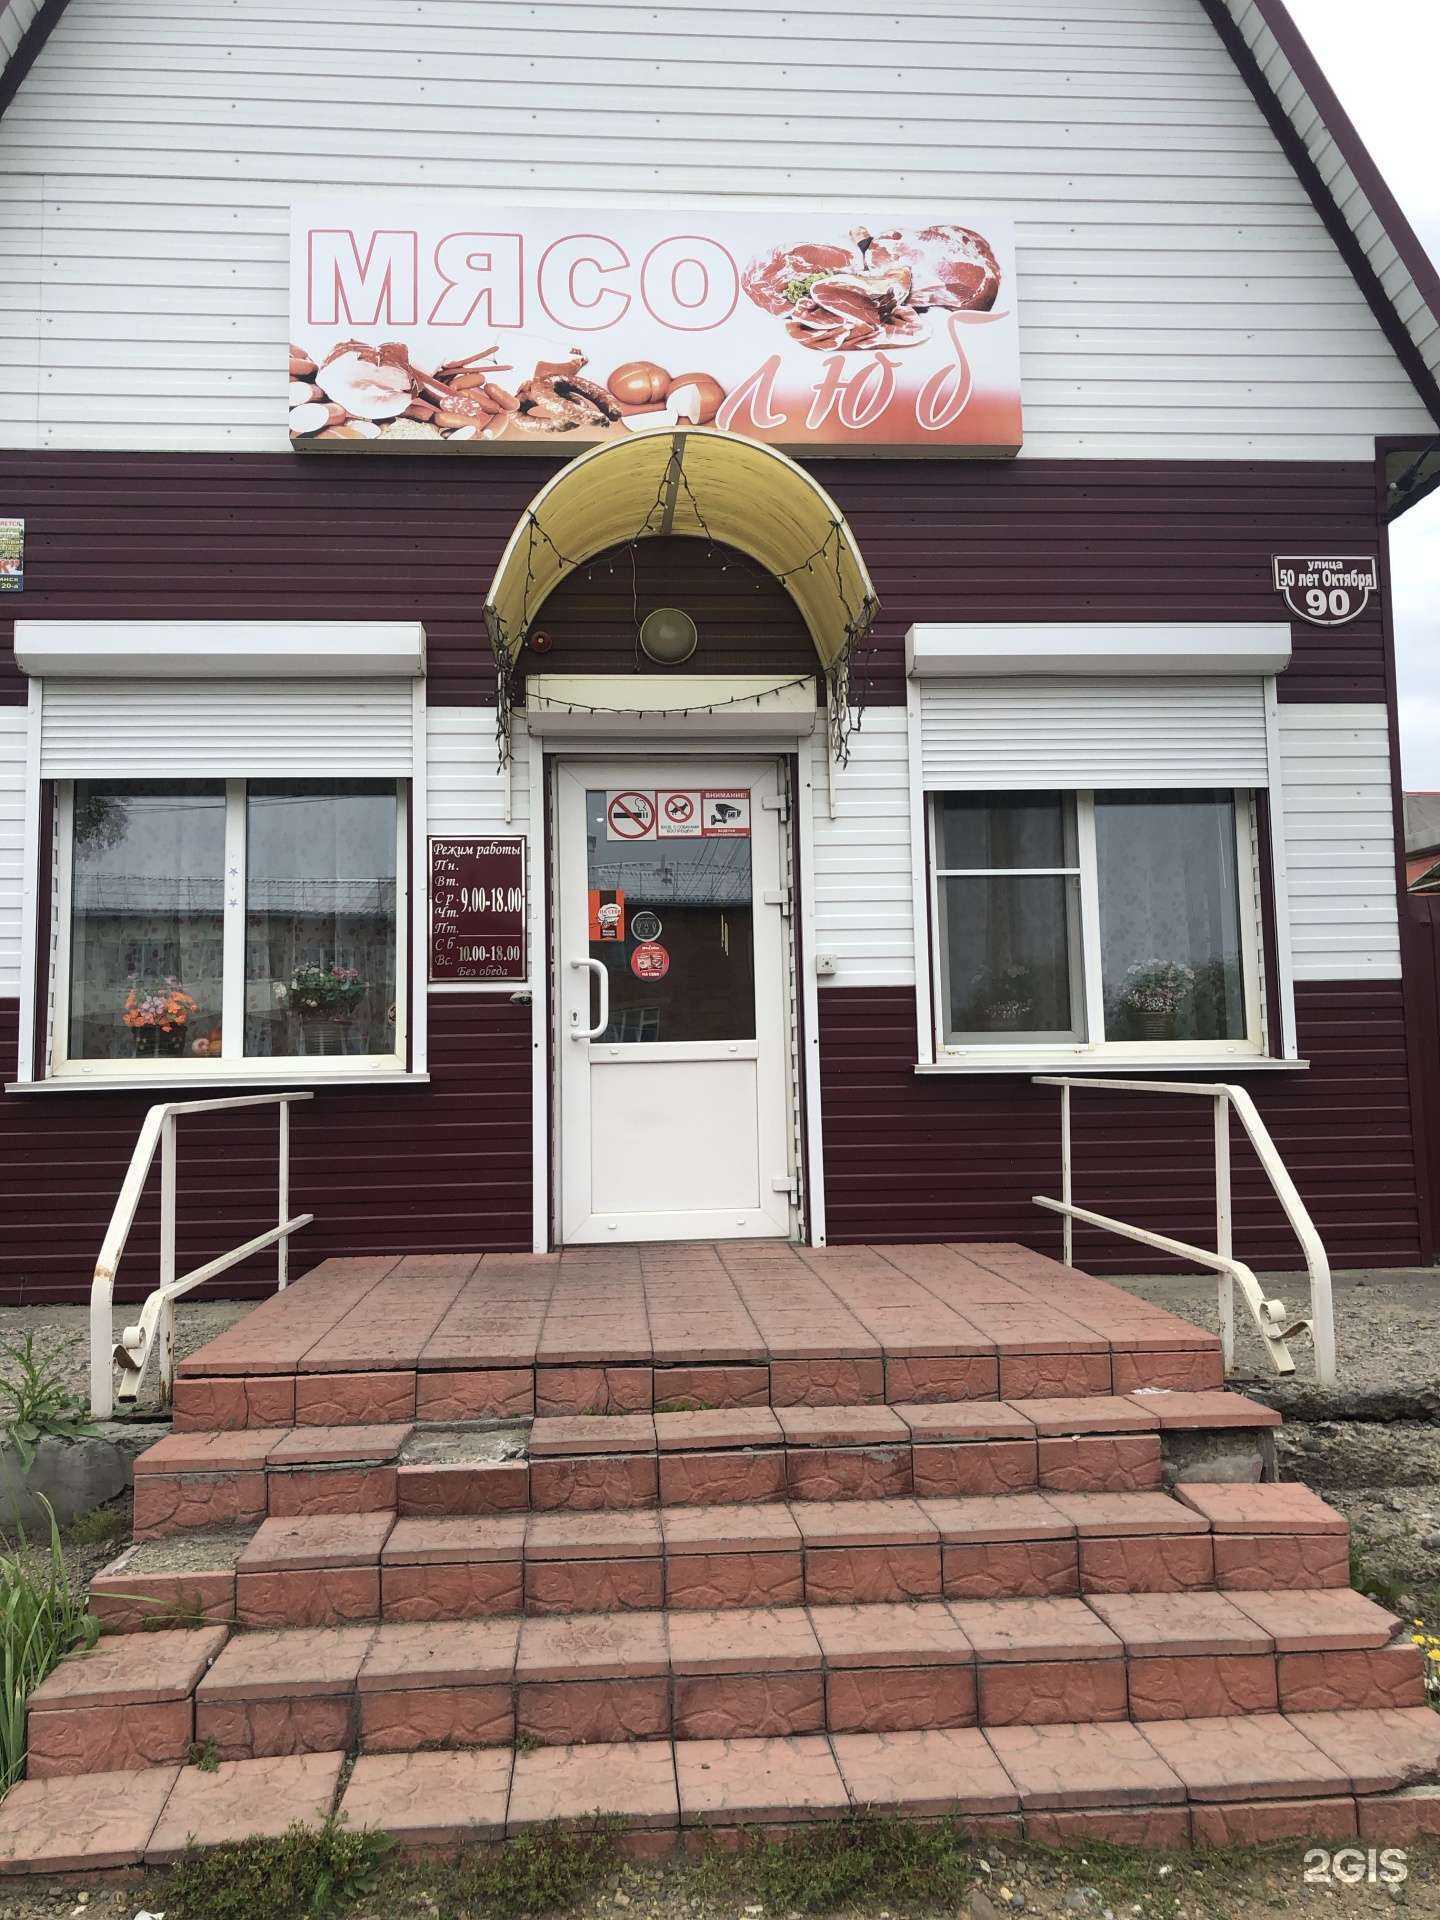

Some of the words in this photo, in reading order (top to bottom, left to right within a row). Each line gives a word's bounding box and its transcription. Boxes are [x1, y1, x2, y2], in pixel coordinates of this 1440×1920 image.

[306, 228, 740, 333] МЯСО
[1307, 560, 1344, 572] улица
[1280, 569, 1295, 587] 50
[1298, 573, 1320, 587] лет
[1322, 569, 1373, 590] Октября
[1305, 588, 1350, 616] 90
[433, 843, 474, 858] Режим
[476, 842, 521, 859] работы
[434, 860, 459, 871] Пн.
[434, 875, 459, 886] Вт.
[461, 887, 522, 913] 9.00-18.00
[434, 906, 459, 918] Чт.
[434, 922, 459, 934] Пт.
[434, 954, 453, 966] Вс.
[458, 945, 520, 962] 10.00-18.00
[457, 966, 477, 977] Без
[479, 965, 508, 976] обеда
